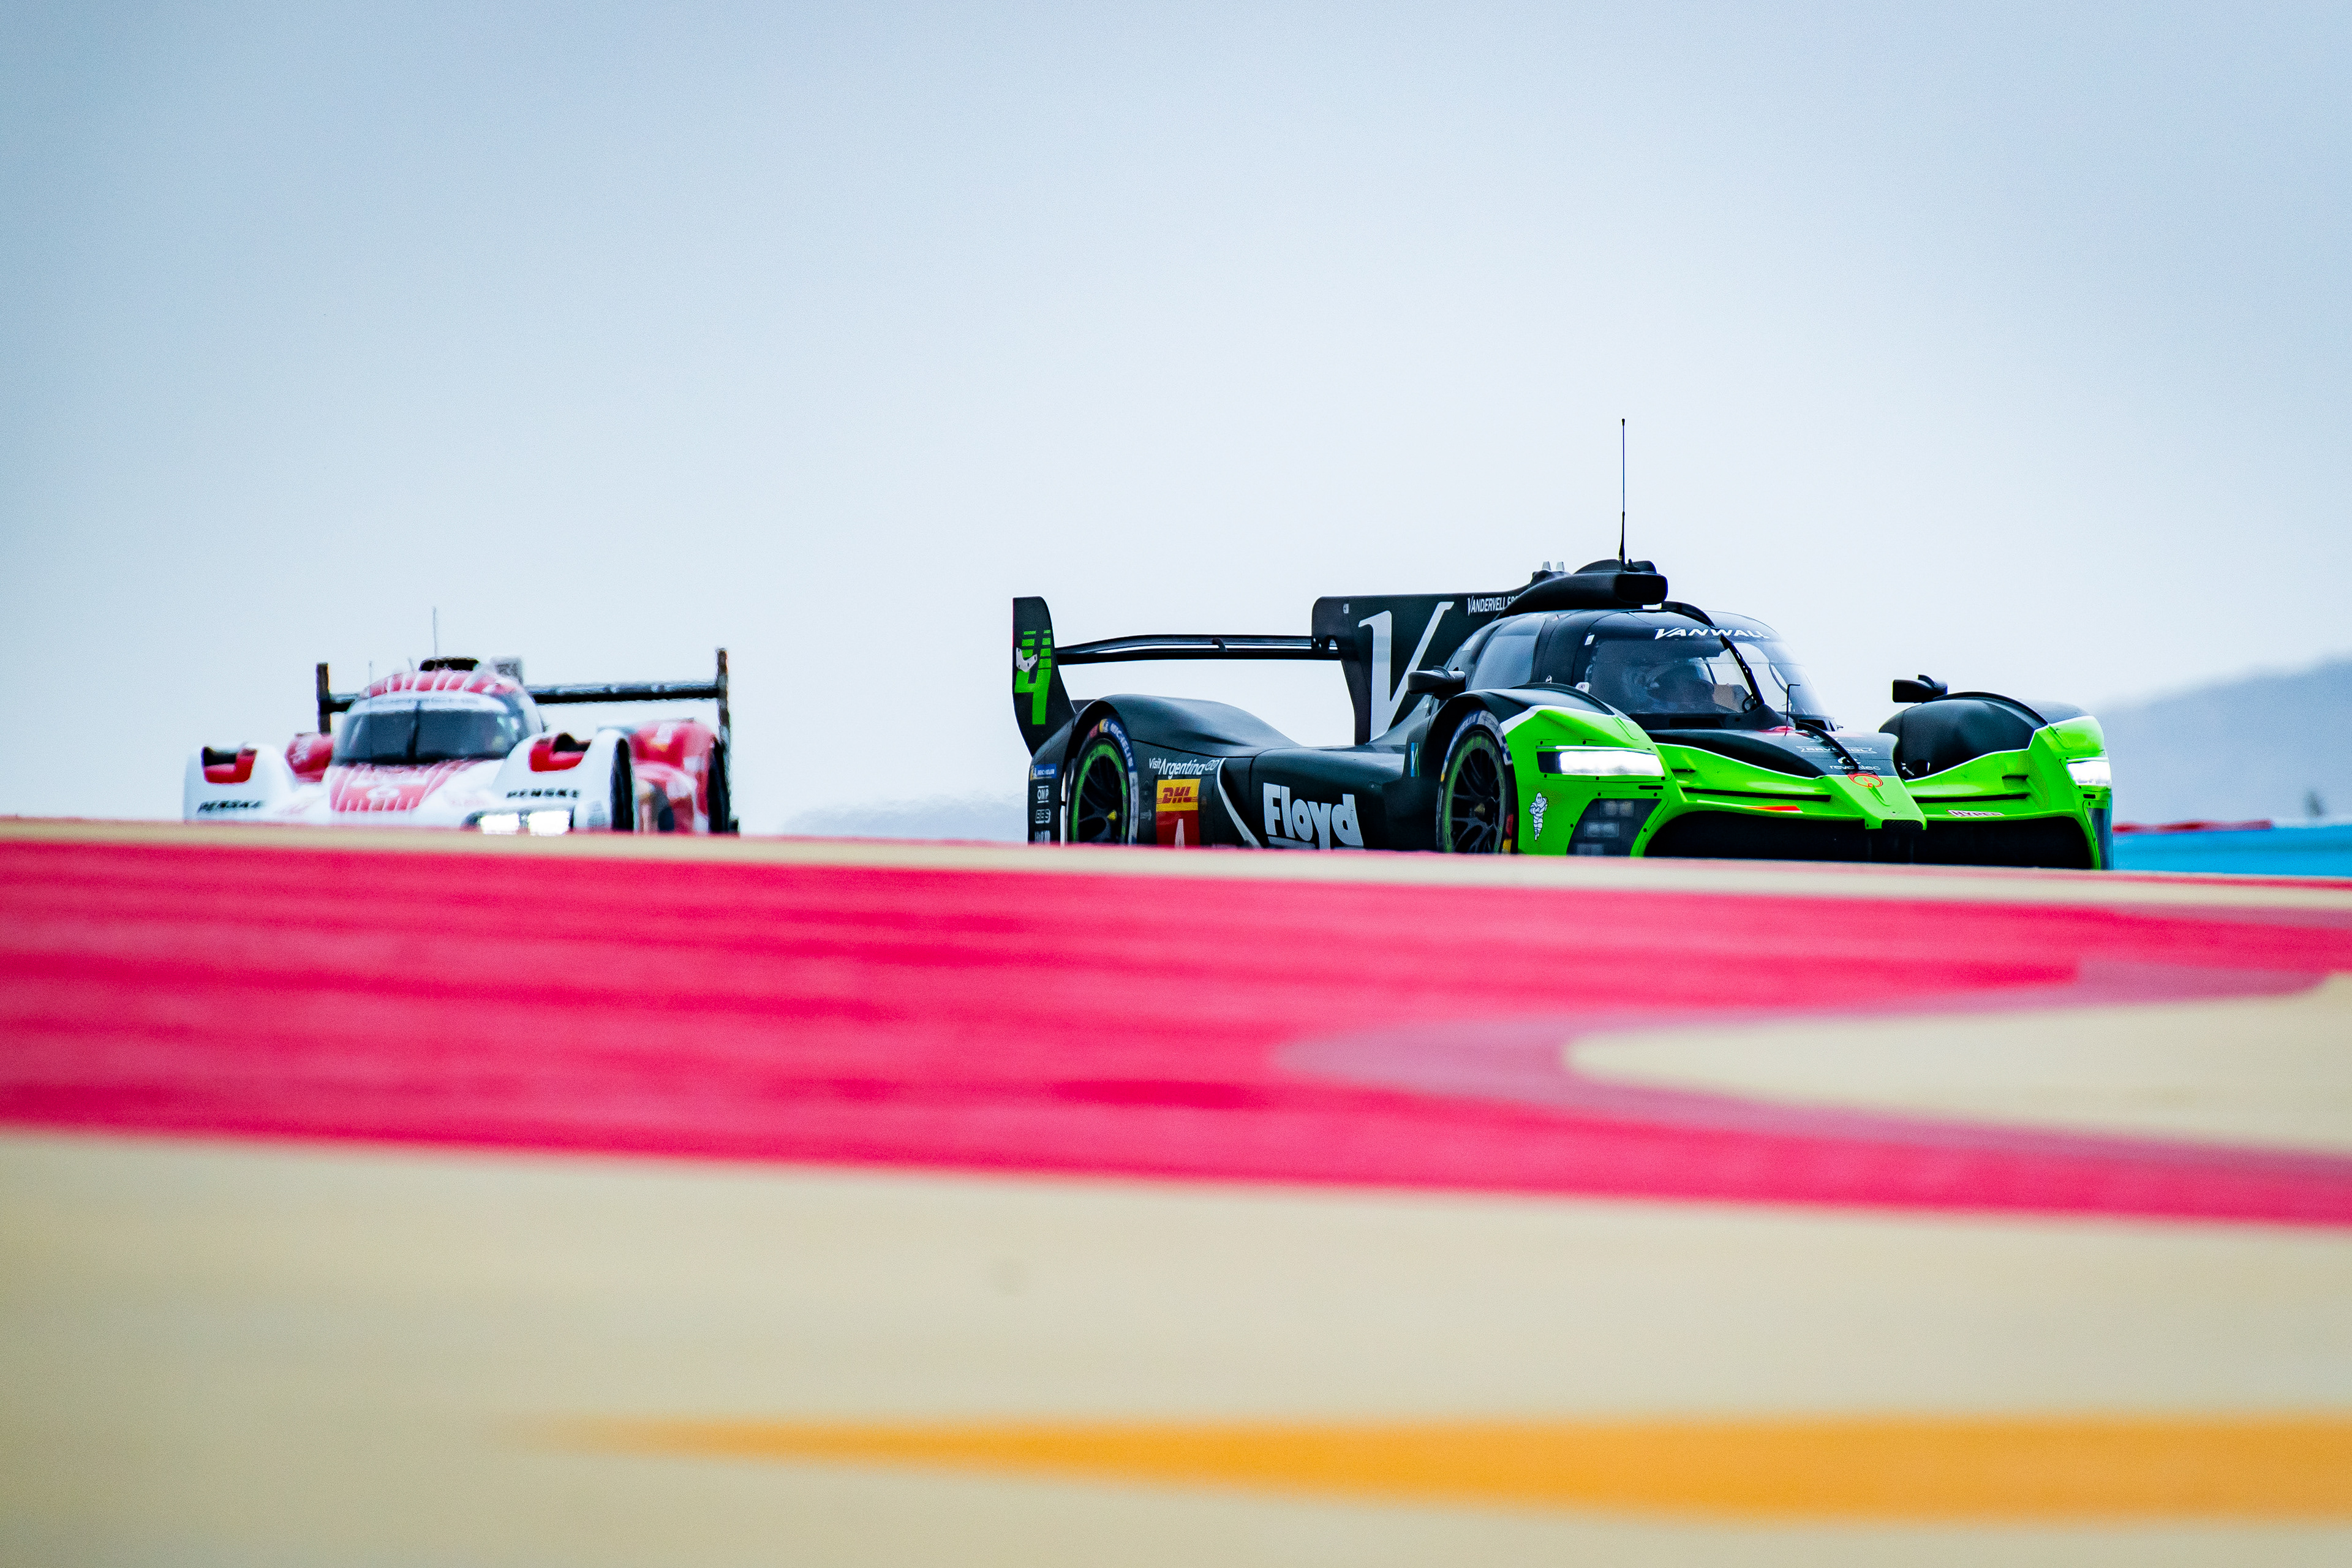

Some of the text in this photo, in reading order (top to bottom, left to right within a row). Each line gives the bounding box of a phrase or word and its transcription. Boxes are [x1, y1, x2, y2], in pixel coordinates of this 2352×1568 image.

[1468, 595, 1506, 616] VANDERVELL
[1655, 627, 1770, 640] VANWALL
[1358, 601, 1454, 743] V
[1149, 758, 1162, 769] Visit
[1158, 758, 1205, 779] Argentina
[1163, 786, 1192, 804] DHL
[1263, 782, 1364, 850] Floyd
